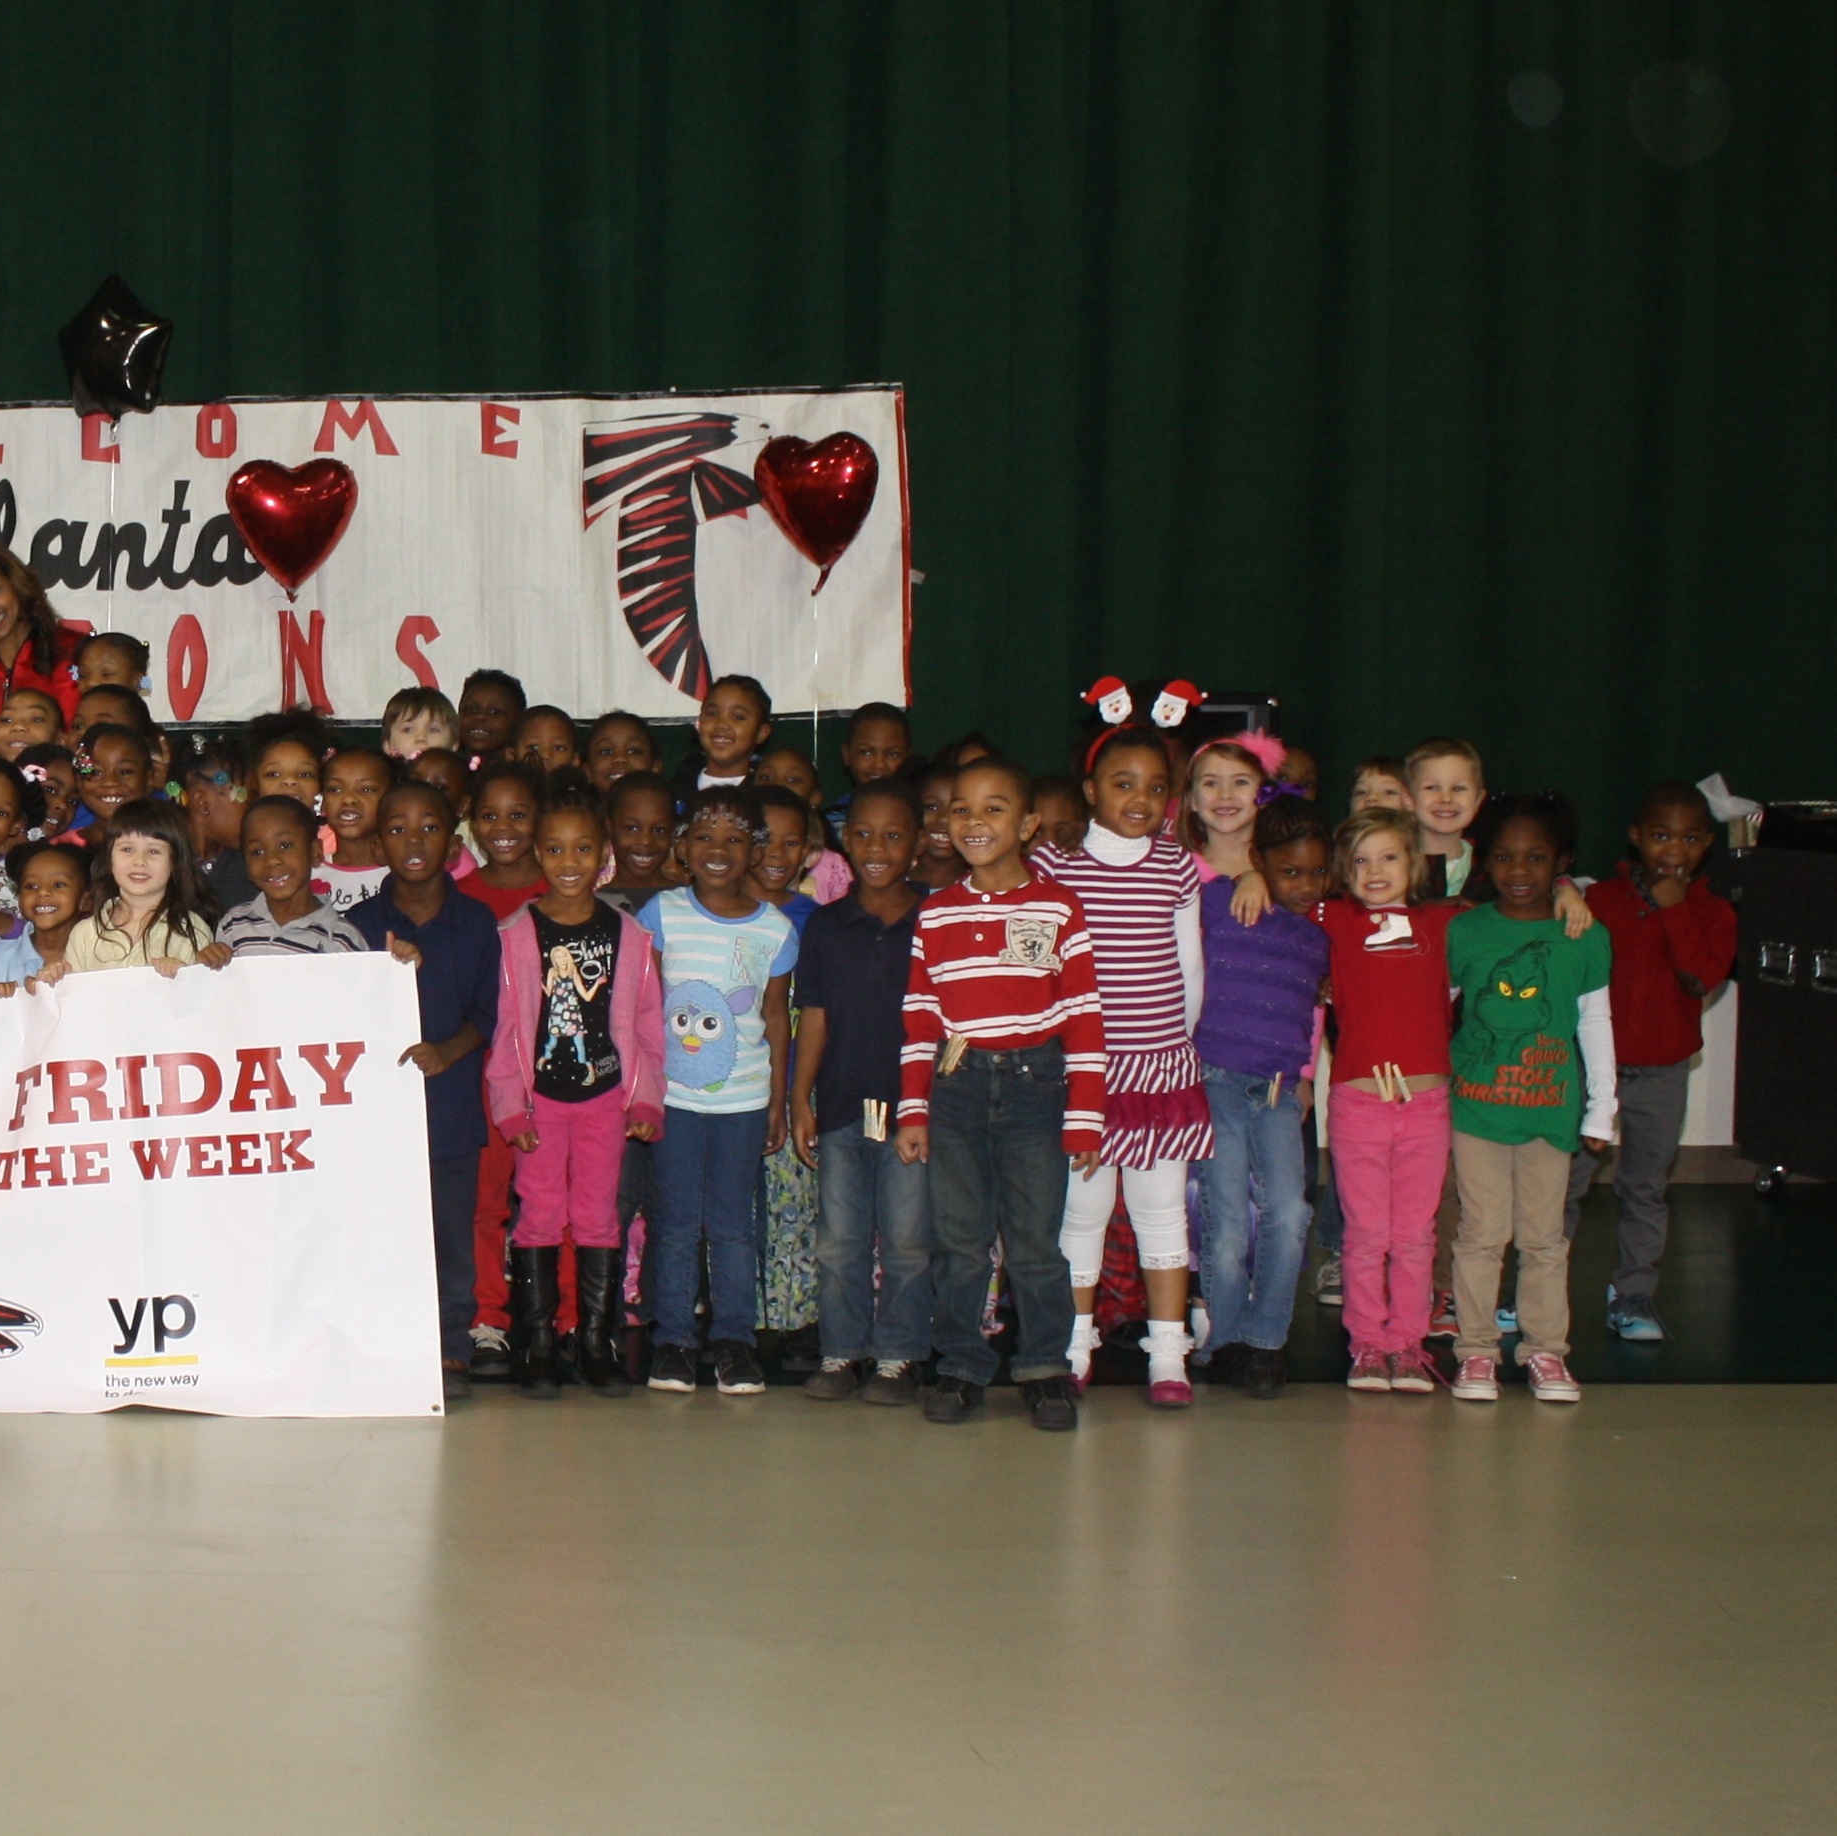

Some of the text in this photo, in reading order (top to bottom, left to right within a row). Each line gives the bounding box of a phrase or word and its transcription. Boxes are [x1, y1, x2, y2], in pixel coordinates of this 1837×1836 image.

[7, 1040, 366, 1132] FRIDAY
[1493, 1064, 1557, 1087] STOLE
[128, 1128, 316, 1181] WEEK
[107, 1293, 197, 1355] yp
[105, 1373, 200, 1388] the new way
